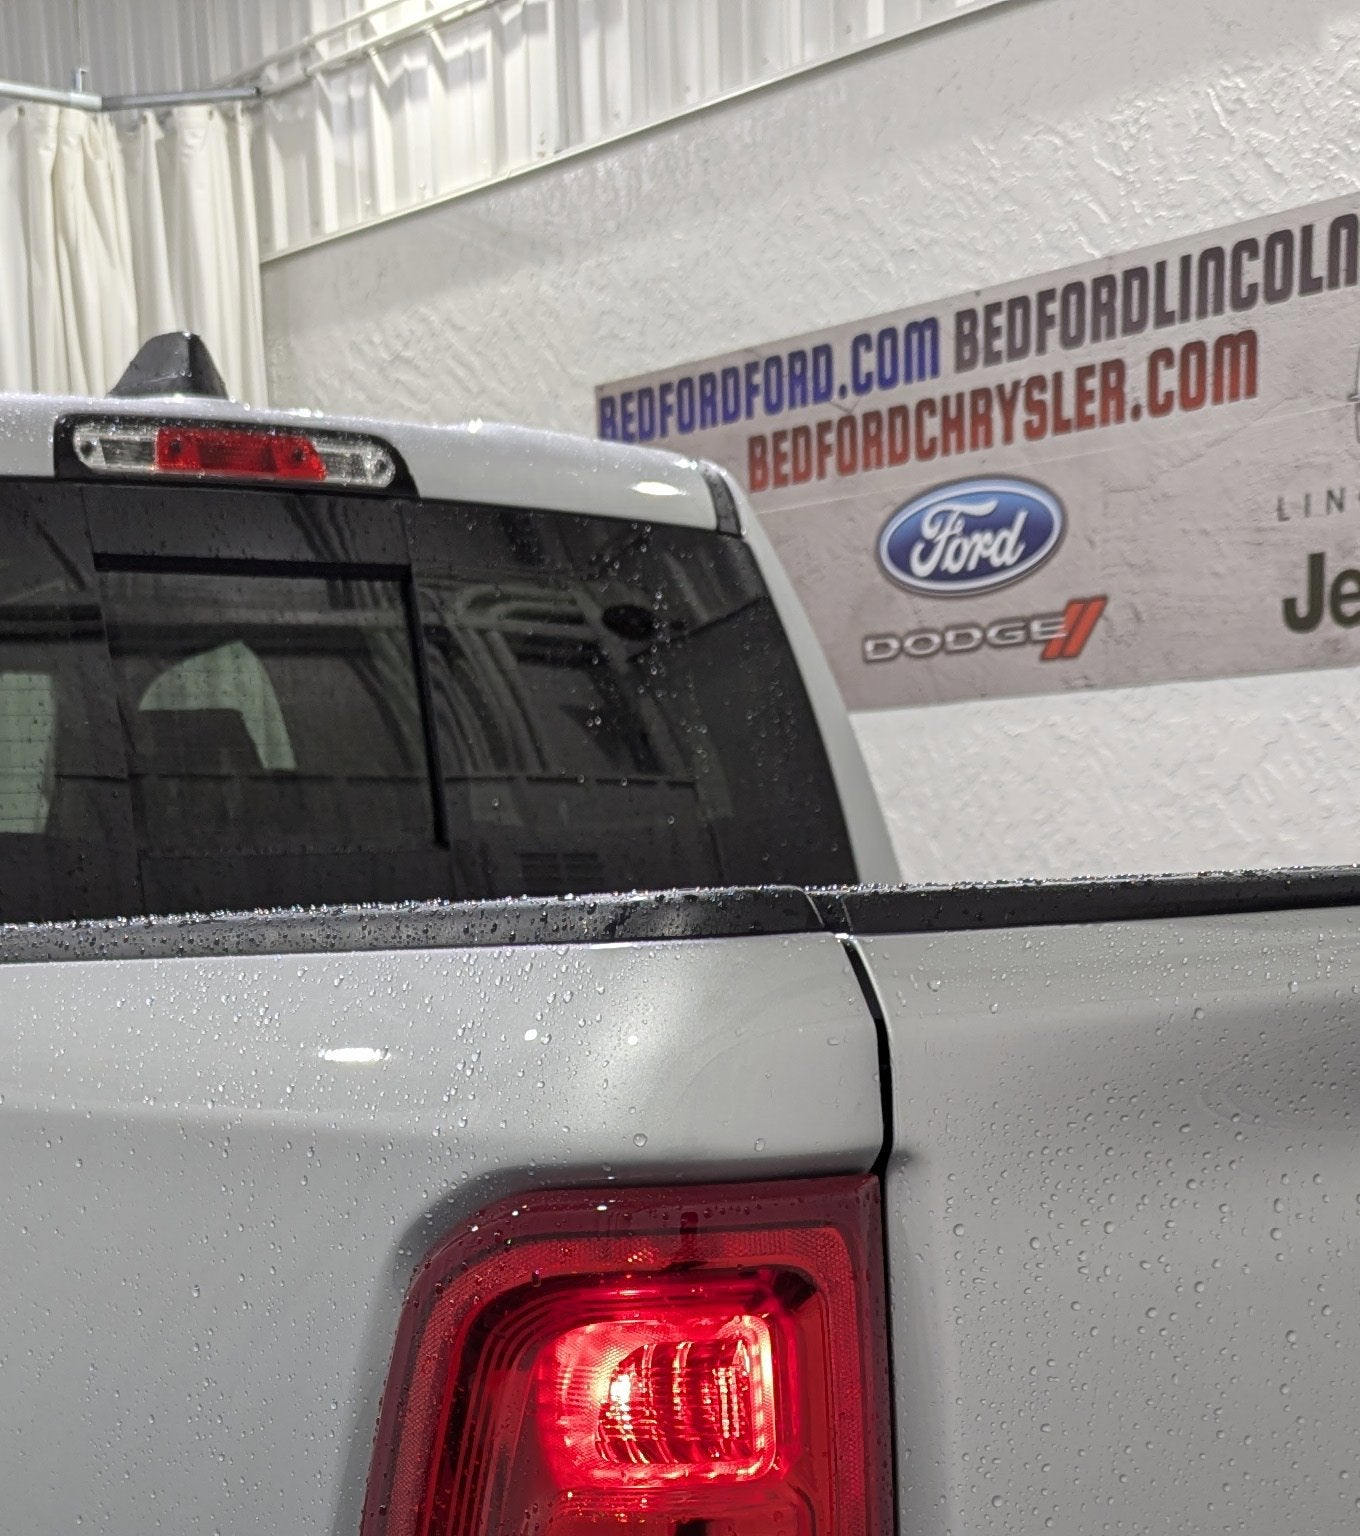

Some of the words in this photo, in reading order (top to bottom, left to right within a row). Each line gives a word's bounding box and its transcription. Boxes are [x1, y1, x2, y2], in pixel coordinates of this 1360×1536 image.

[599, 316, 940, 444] BEDFORDFORD.COM
[748, 329, 1258, 494] BEDFORDCHRYSLER.COM
[910, 499, 1028, 577] Ford
[862, 611, 1067, 664] DODGE
